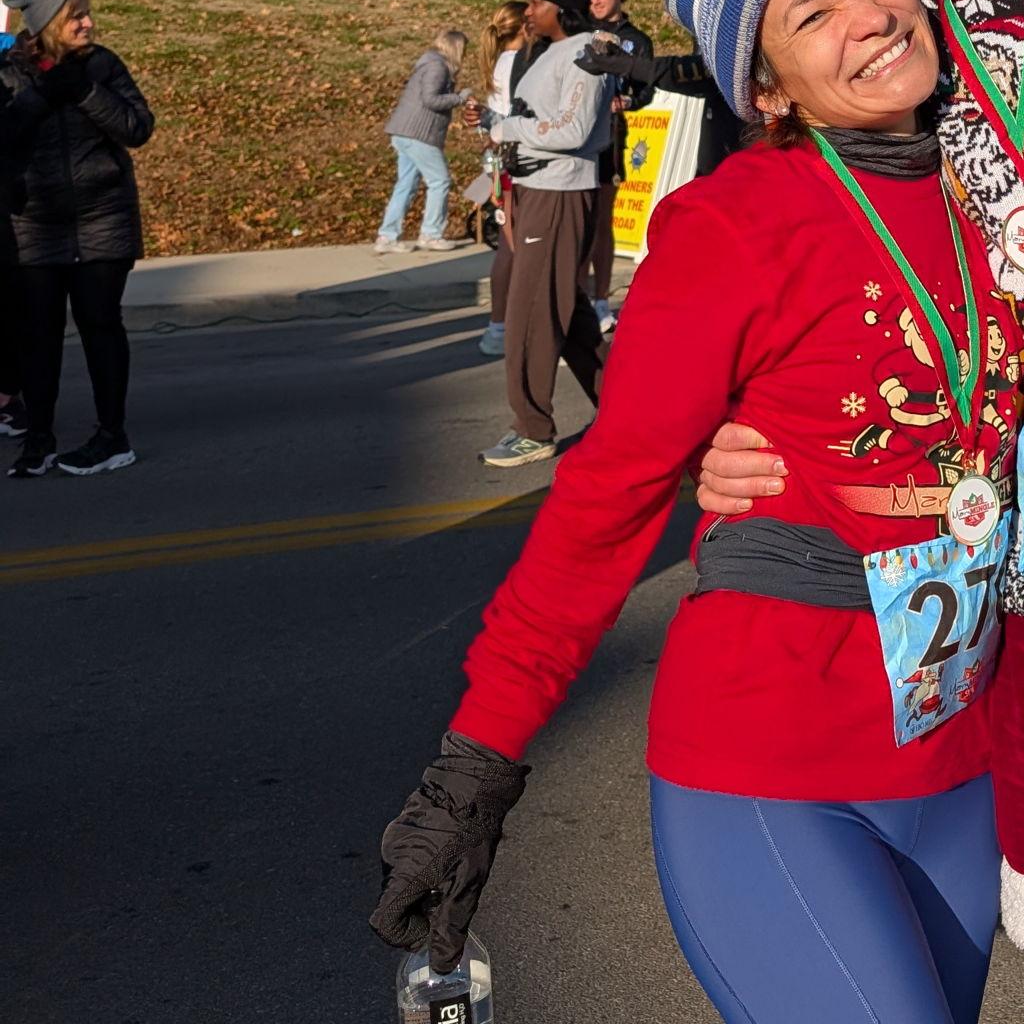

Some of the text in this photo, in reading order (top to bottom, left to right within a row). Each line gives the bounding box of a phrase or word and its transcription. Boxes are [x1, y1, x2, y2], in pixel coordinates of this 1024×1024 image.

[627, 116, 670, 130] CAUTION
[628, 199, 644, 212] THE
[612, 218, 635, 231] ROAD
[889, 474, 949, 518] Mar
[907, 563, 1003, 668] 27
